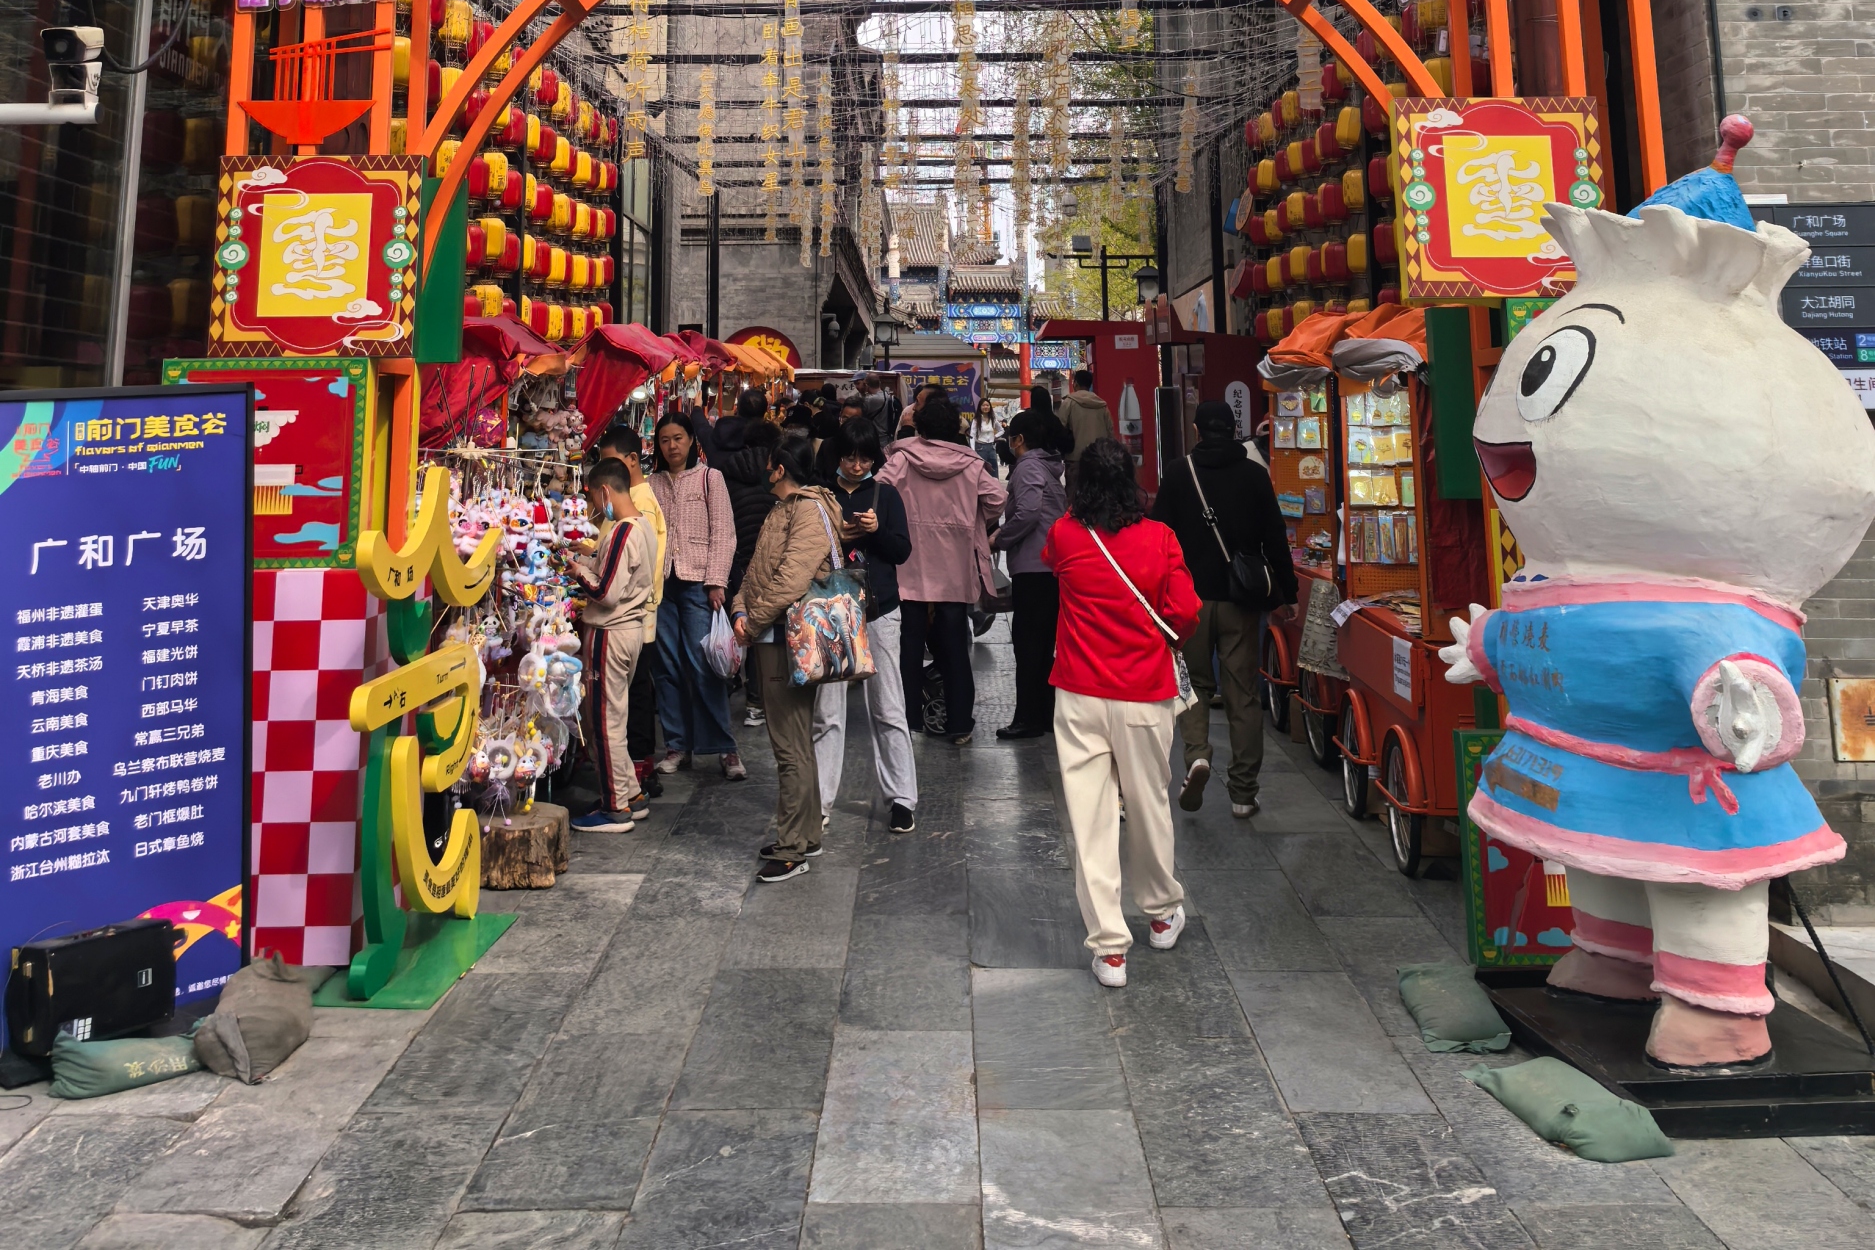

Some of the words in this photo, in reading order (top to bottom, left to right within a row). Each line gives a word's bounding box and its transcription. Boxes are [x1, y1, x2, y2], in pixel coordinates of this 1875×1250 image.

[760, 22, 783, 192] 卧看牵牛织女星
[1792, 214, 1846, 228] 广和广场
[1824, 230, 1849, 238] Square
[1801, 295, 1856, 310] 大江胡同
[1802, 311, 1827, 319] Dajiang
[30, 526, 207, 575] 广和广场
[16, 602, 103, 625] 福州非遗灌蛋
[142, 592, 199, 612] 天津奥华
[141, 618, 199, 638] 宁夏早茶
[16, 628, 103, 652] 霞浦非遗美食
[141, 644, 198, 665] 福建光饼
[16, 655, 103, 680] 天桥非遗茶汤
[141, 671, 198, 692] 门钉肉饼
[31, 684, 89, 706] 青海美食
[141, 698, 198, 719] 西部马华
[31, 712, 89, 734] 云南美食
[134, 723, 205, 747] 常赢三兄弟
[31, 740, 89, 763] 重庆美食
[112, 746, 226, 778] 乌兰察布联营烧麦
[37, 771, 82, 790] 老川办
[119, 774, 218, 805] 九门轩烤鸭卷饼
[24, 794, 96, 821] 哈尔滨美食
[134, 804, 204, 830] 老门框爆肚
[10, 820, 110, 853] 内蒙古河套美食
[134, 831, 205, 858] 日式章鱼烧
